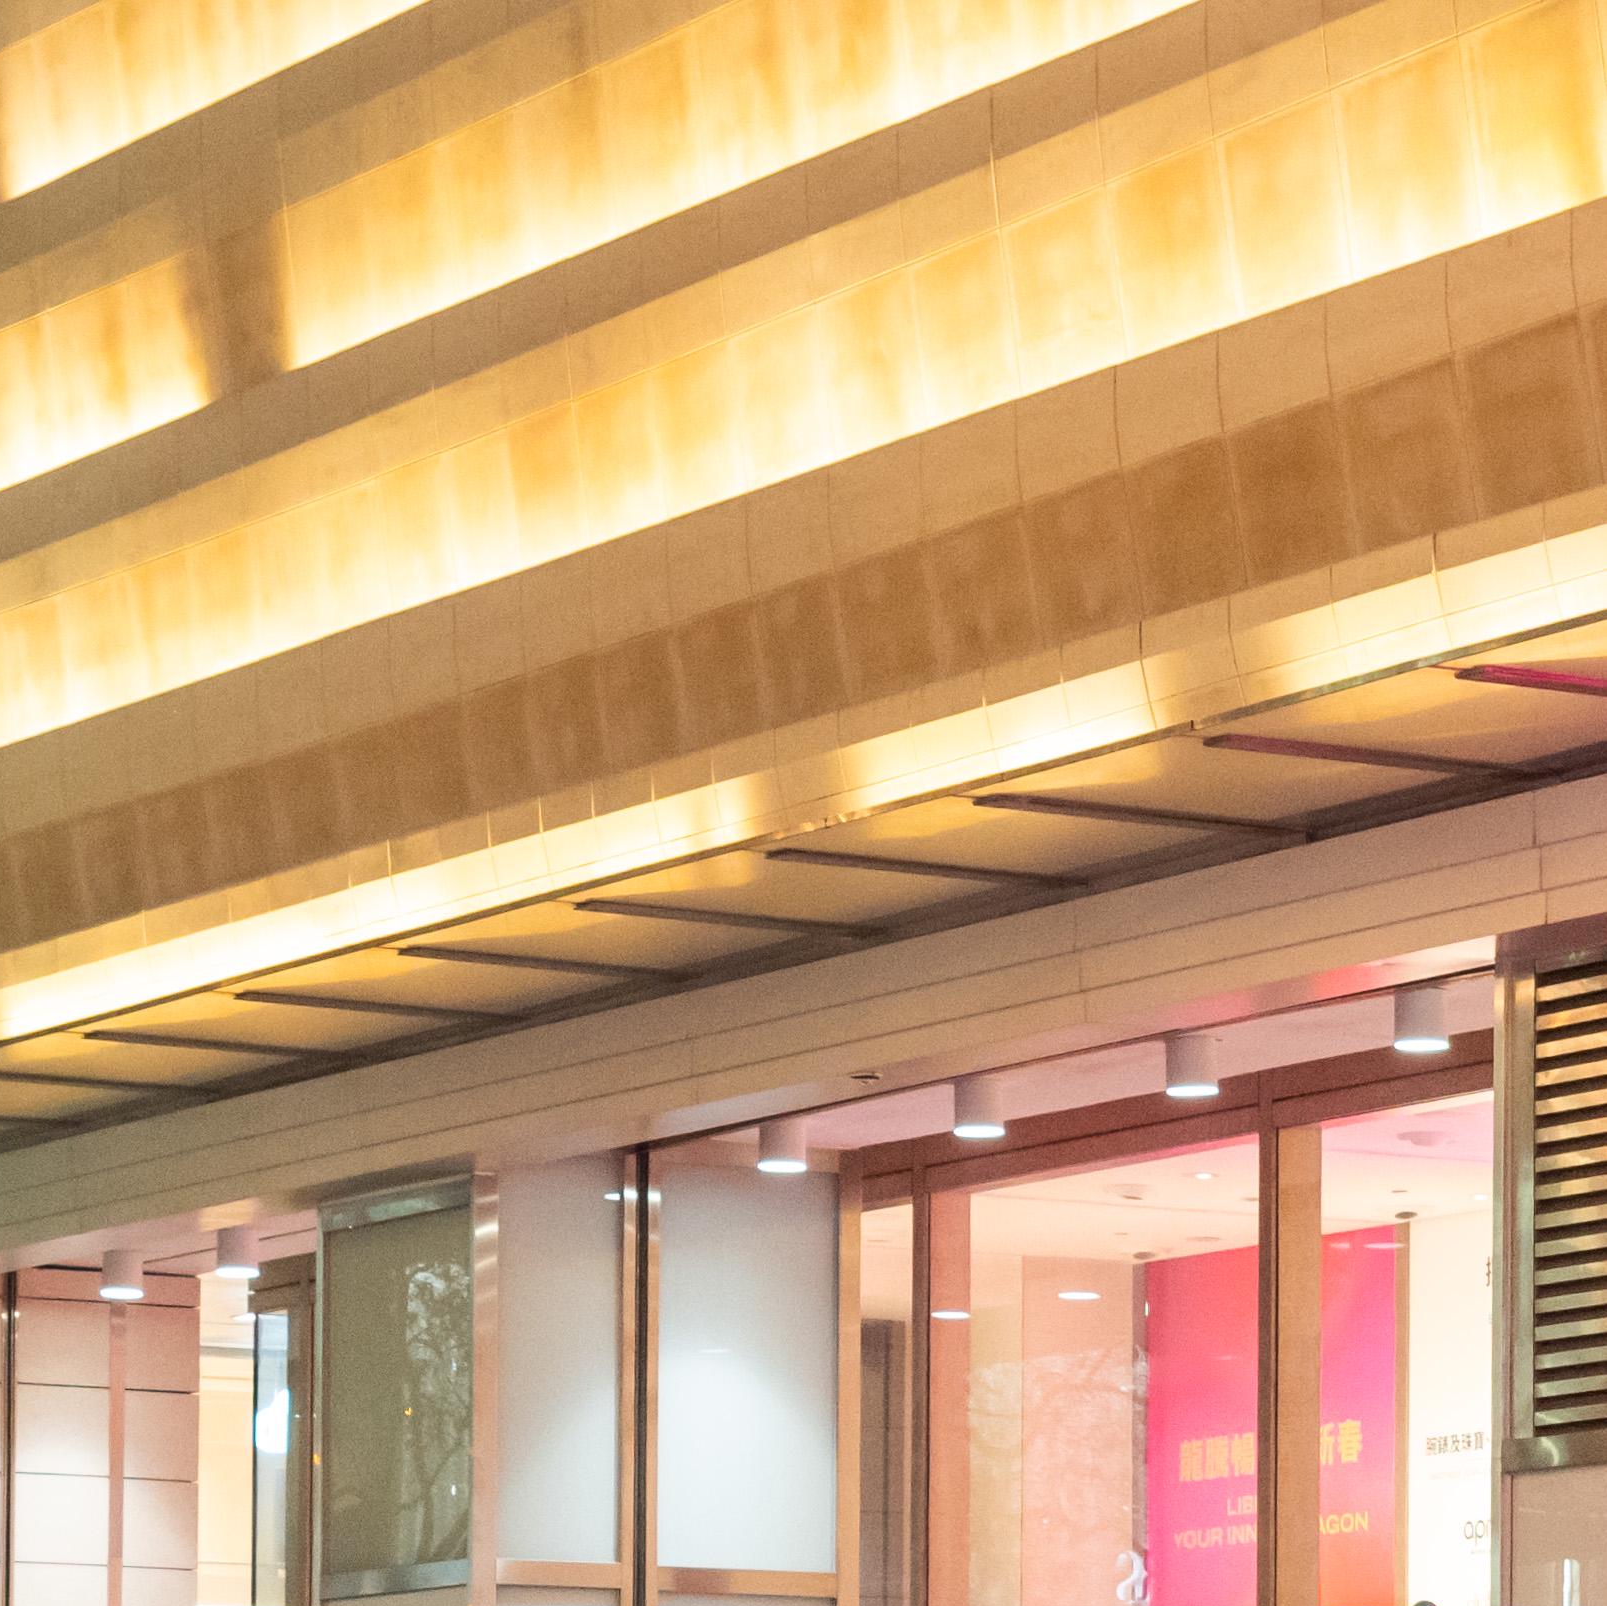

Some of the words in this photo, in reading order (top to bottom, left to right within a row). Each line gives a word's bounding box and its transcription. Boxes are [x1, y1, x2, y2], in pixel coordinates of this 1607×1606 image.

[1174, 1526, 1223, 1549] YOUR
[1227, 1523, 1257, 1545] INN
[1319, 1511, 1369, 1536] AGON
